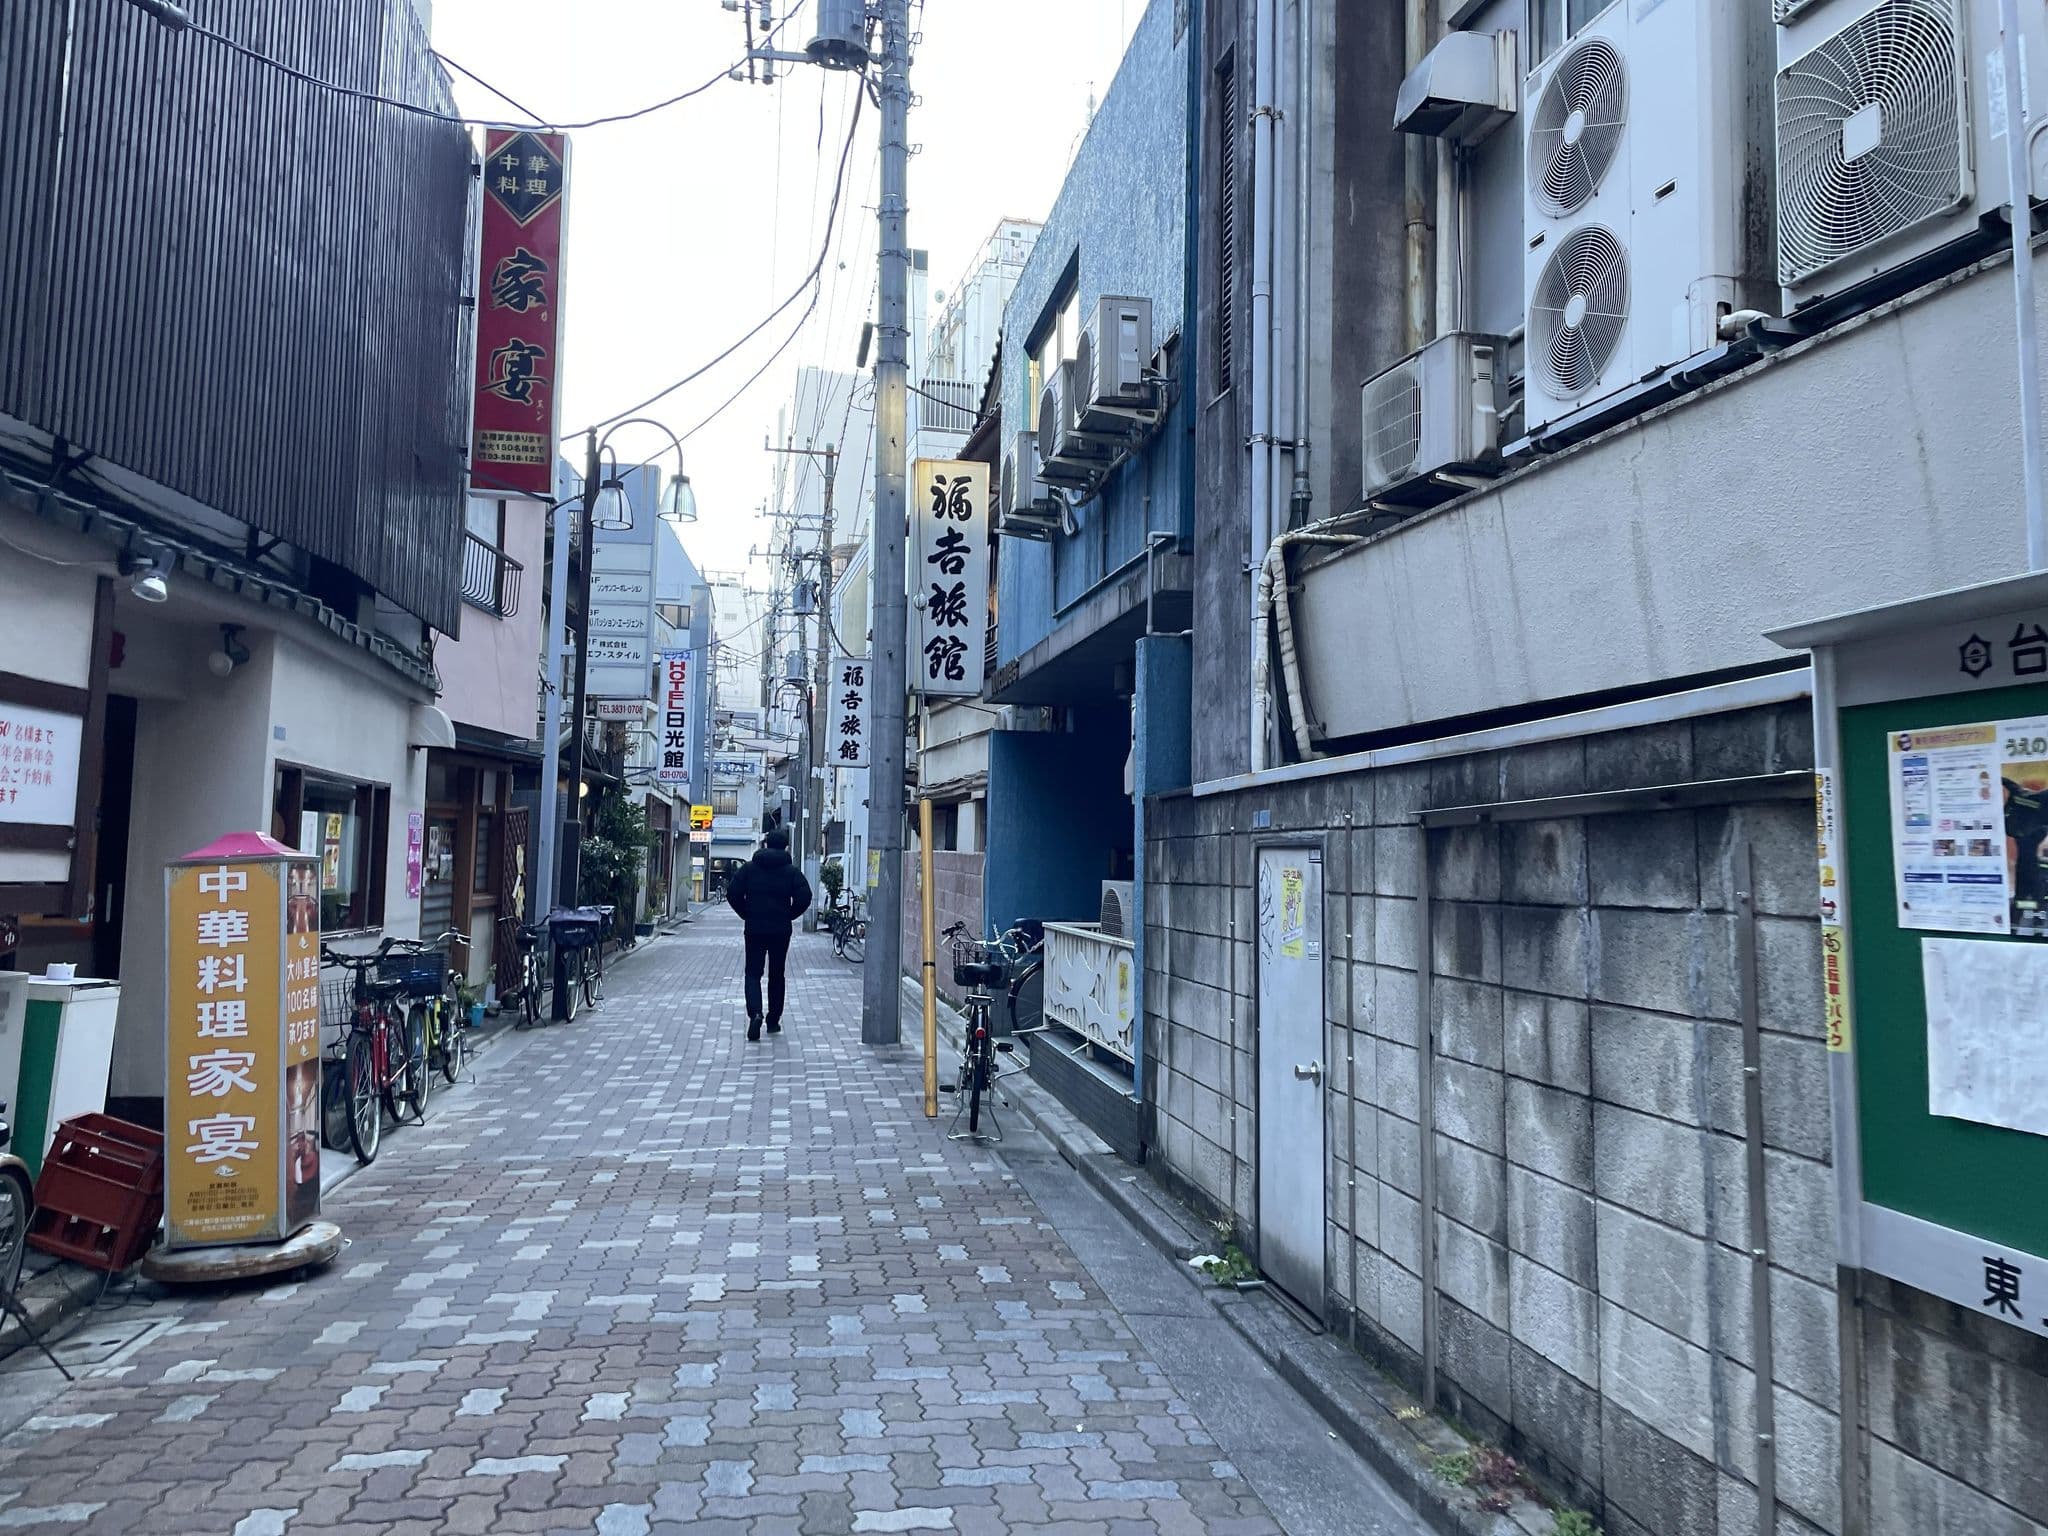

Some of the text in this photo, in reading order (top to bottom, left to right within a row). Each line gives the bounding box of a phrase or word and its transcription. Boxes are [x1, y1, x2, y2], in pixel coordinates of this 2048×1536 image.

[498, 153, 549, 174] 中華
[495, 175, 548, 197] 料理
[924, 474, 973, 682] 福吉旅館
[599, 640, 628, 649] 株式会社
[663, 651, 692, 660] ビジネス
[2008, 622, 2048, 676] 台
[838, 665, 864, 761] 福吉旅館
[287, 955, 318, 981] 大小宴会
[287, 986, 317, 1013] 100名様
[289, 1018, 316, 1045] 承ります
